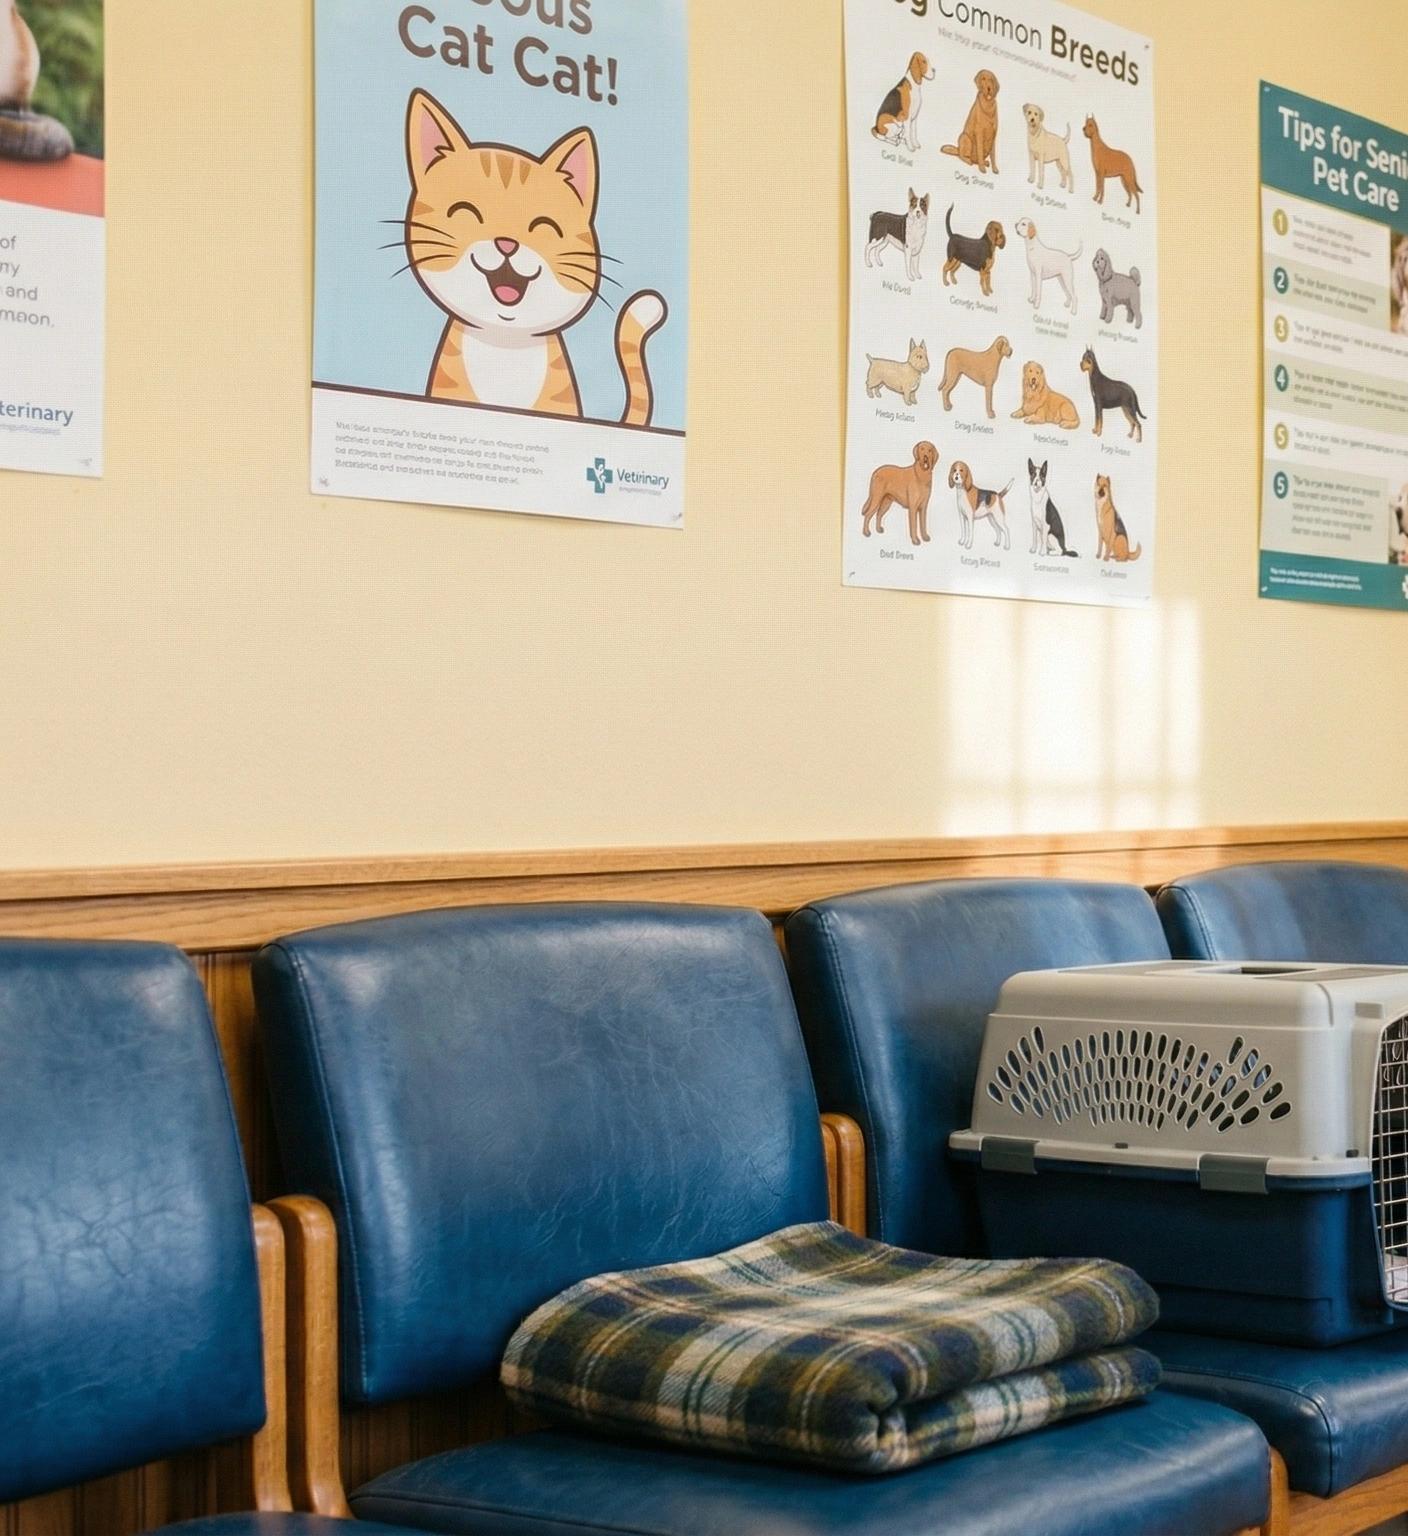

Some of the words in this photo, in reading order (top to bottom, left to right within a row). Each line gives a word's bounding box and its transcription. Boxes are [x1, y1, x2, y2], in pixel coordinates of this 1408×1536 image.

[398, 5, 494, 74] Cat
[514, 36, 618, 106] Cat!
[938, 0, 1043, 50] Common
[1050, 24, 1140, 86] Breeds
[1278, 105, 1326, 151] Tips
[1330, 124, 1362, 162] for
[1313, 156, 1350, 196] Pet
[1353, 171, 1400, 212] Care
[5, 286, 38, 301] and
